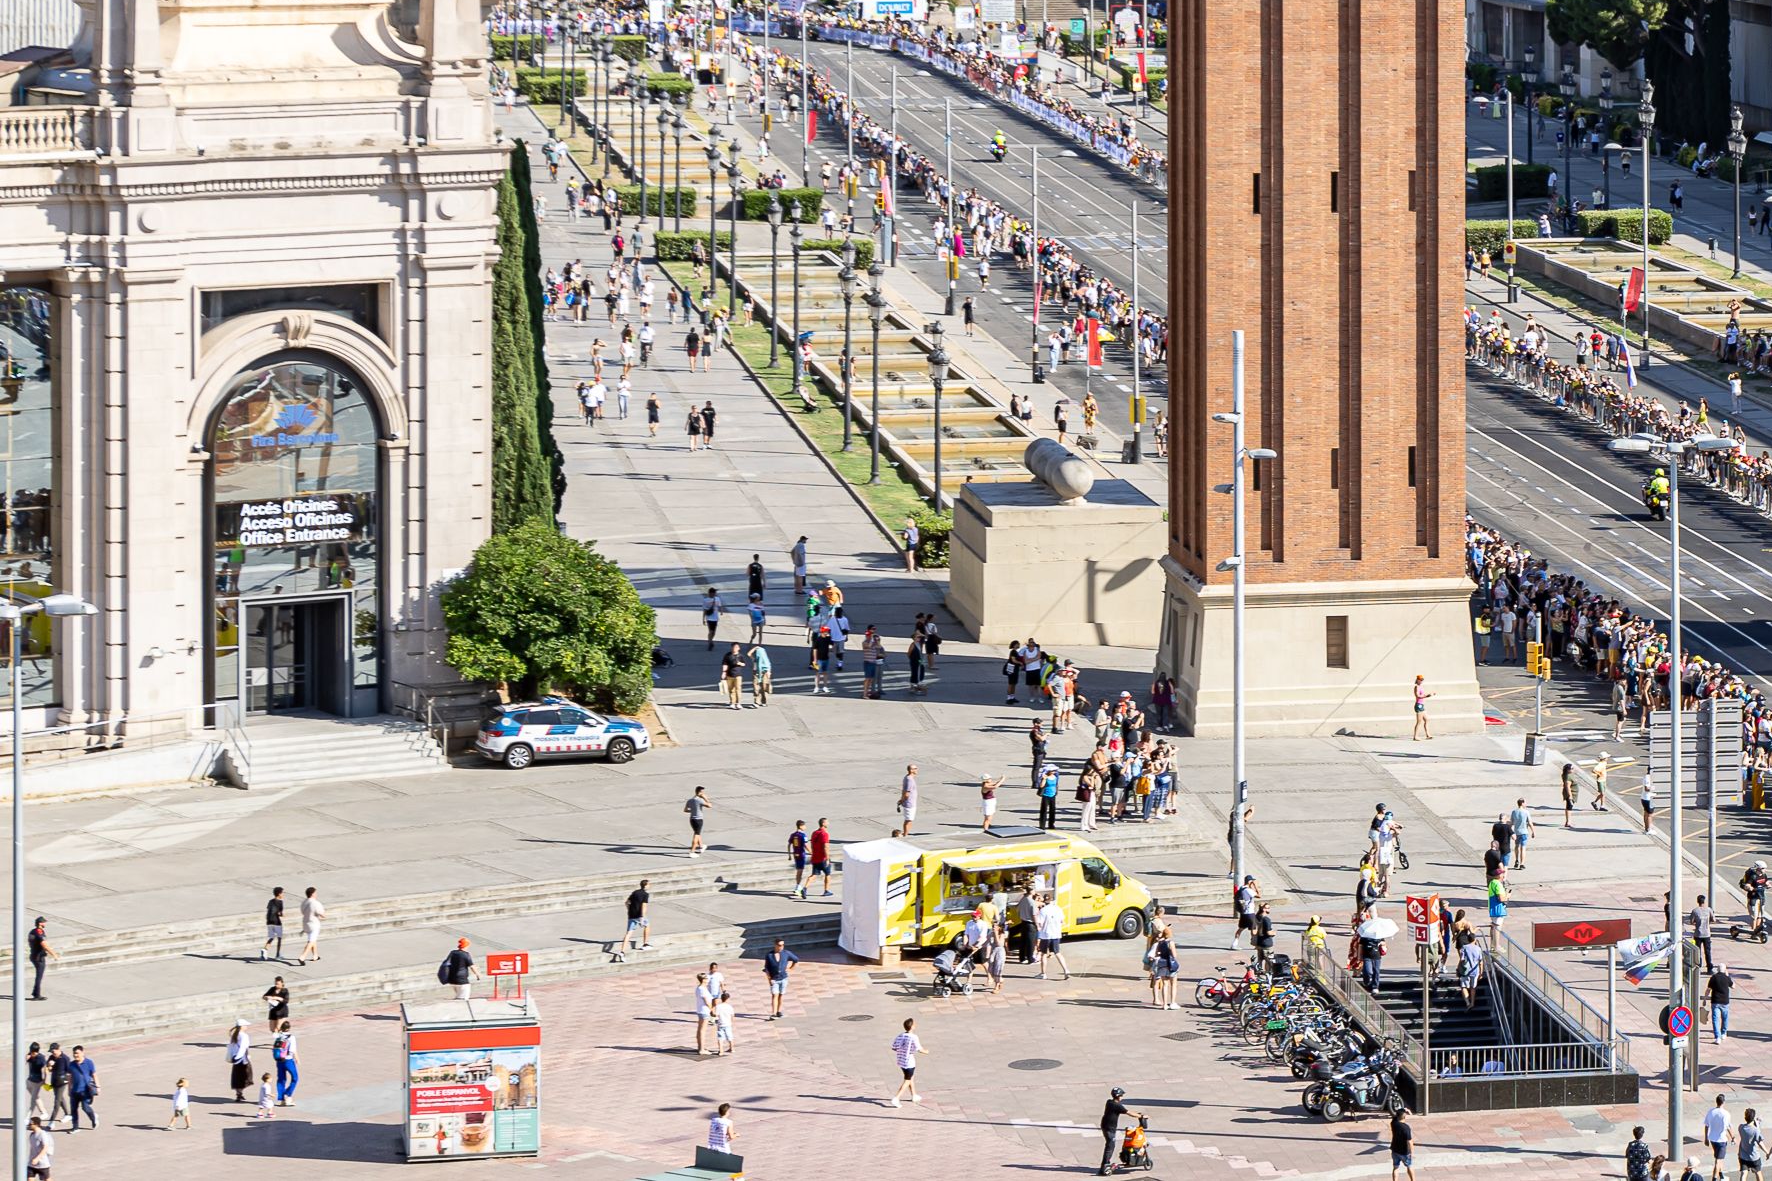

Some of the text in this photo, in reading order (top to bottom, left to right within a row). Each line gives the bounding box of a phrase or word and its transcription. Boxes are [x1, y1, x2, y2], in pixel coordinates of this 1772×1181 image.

[878, 2, 911, 12] DOUBLET
[252, 434, 275, 447] Fira
[240, 500, 338, 517] Accés Oficines
[240, 512, 353, 531] Acceso Oficinas
[240, 527, 350, 545] Office Entrance
[1416, 929, 1426, 939] L1
[416, 1088, 481, 1097] POBLE ESPANYOL
